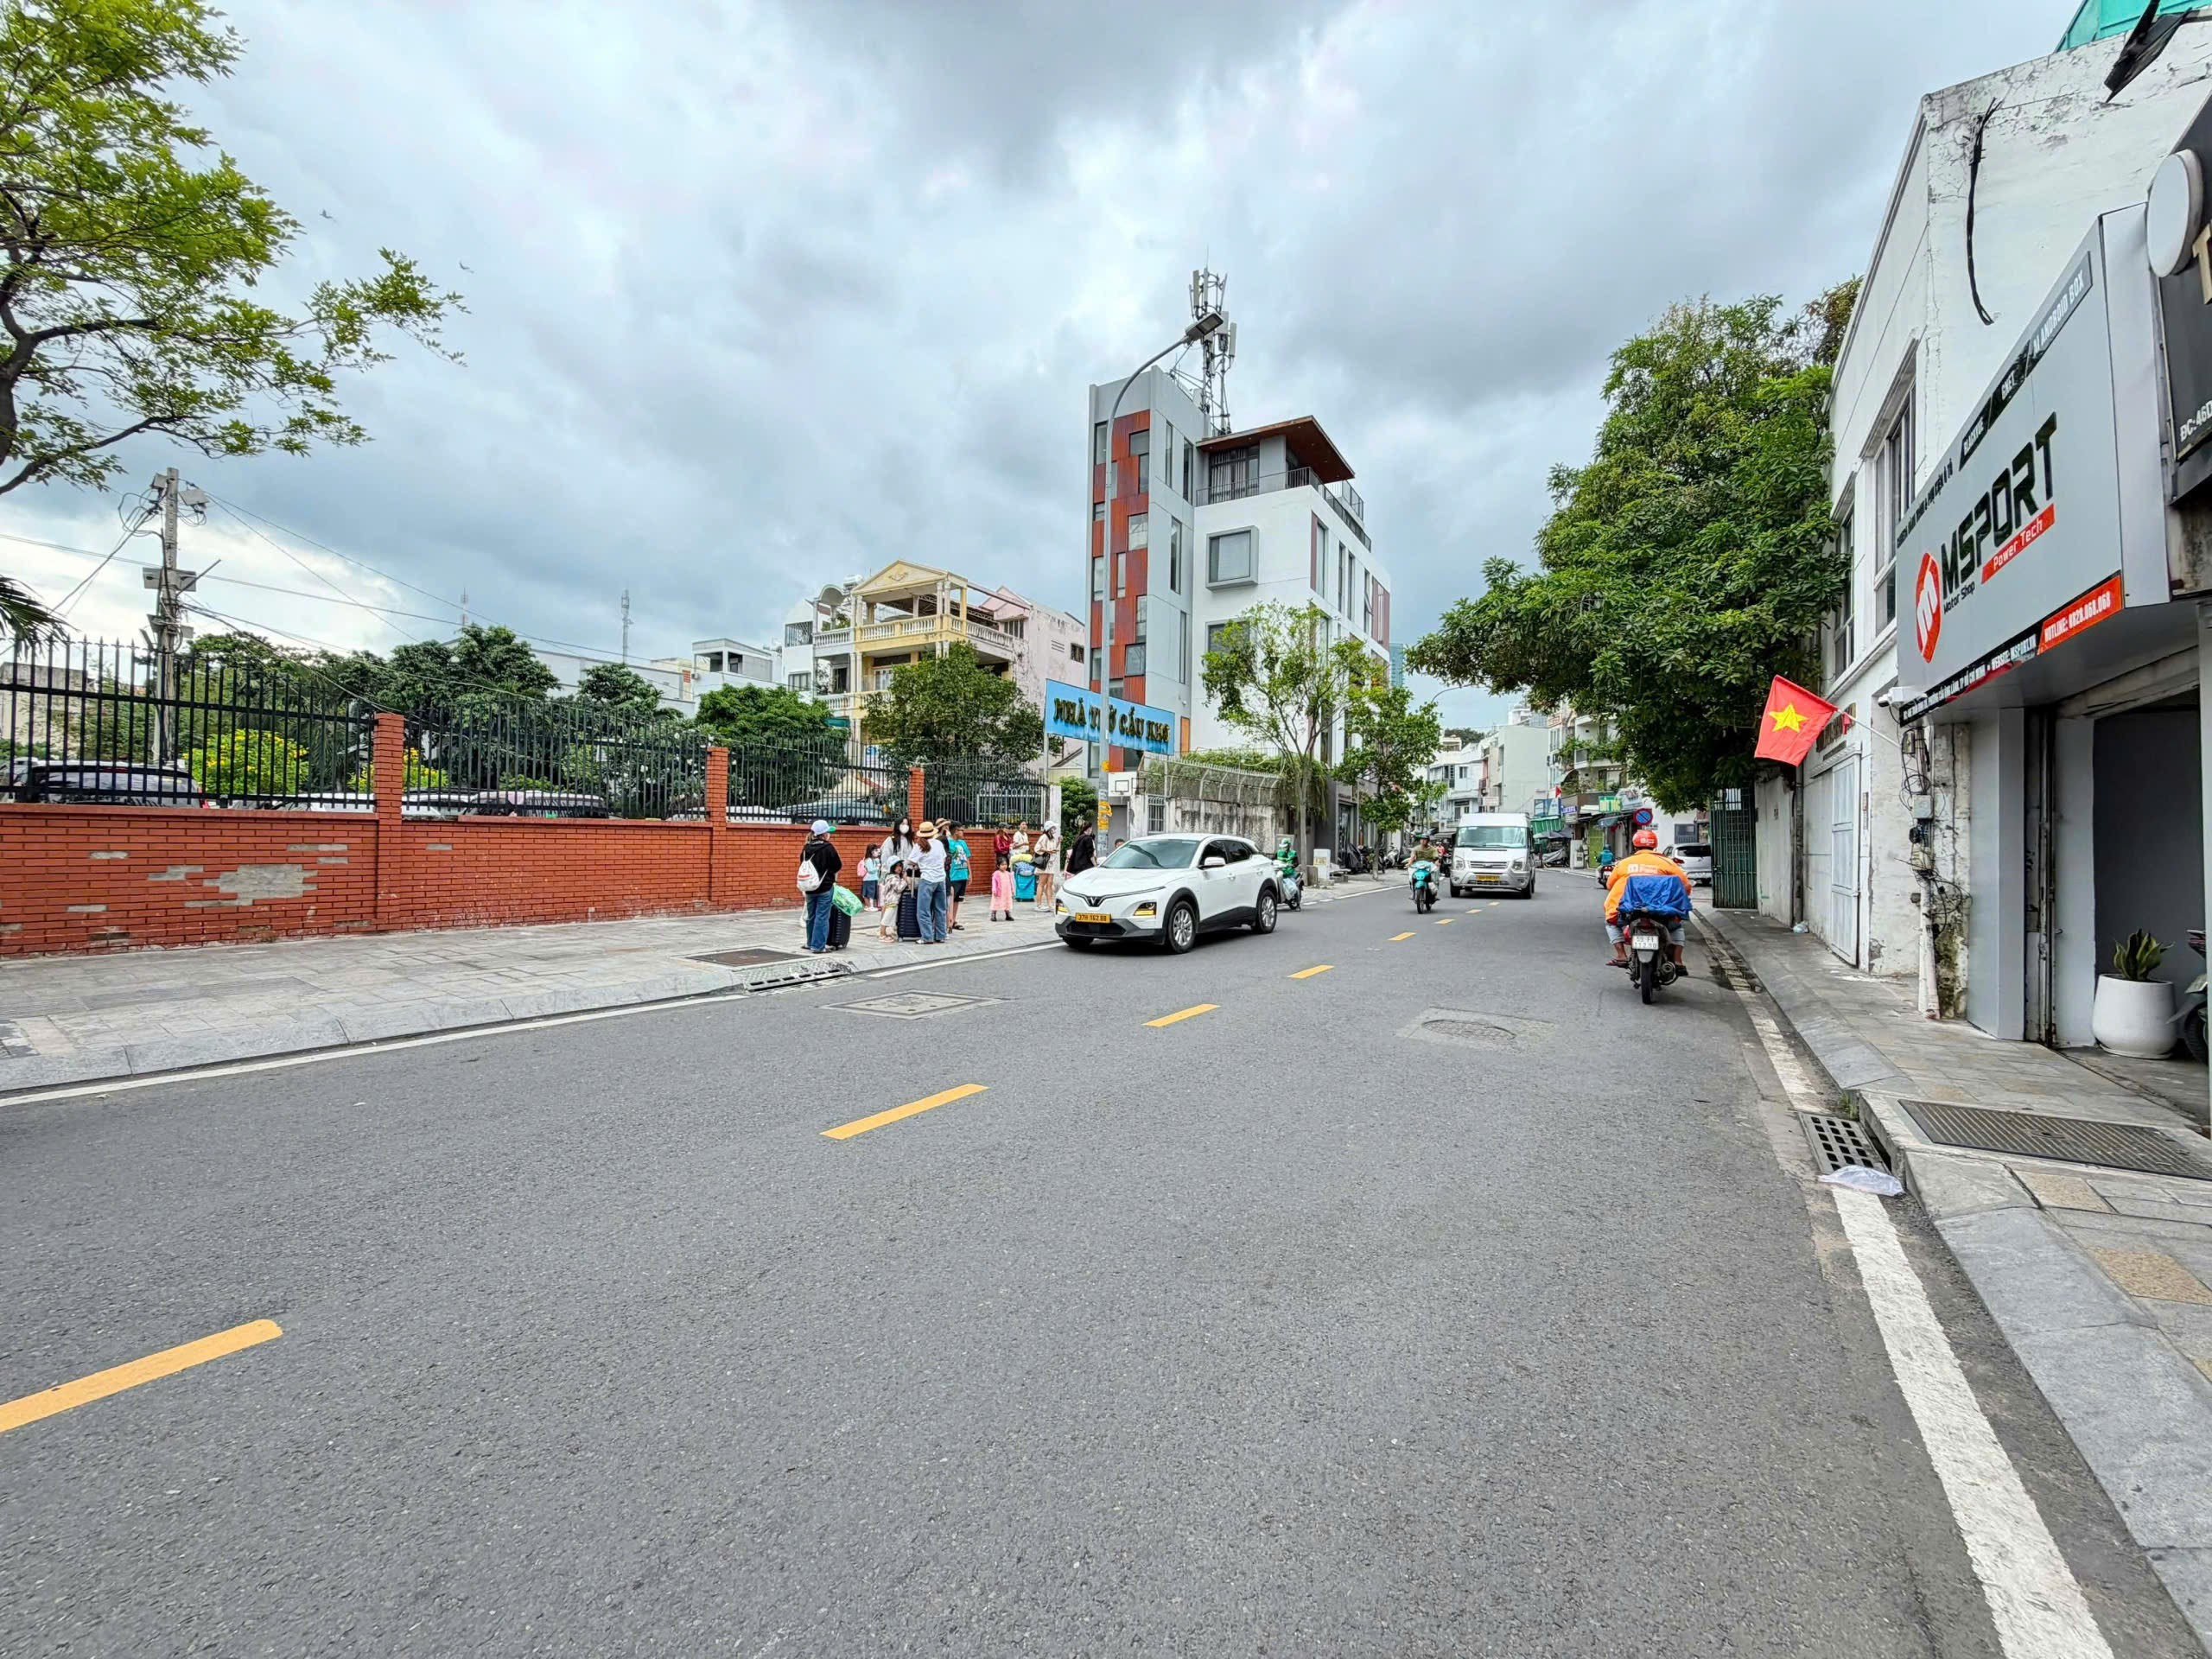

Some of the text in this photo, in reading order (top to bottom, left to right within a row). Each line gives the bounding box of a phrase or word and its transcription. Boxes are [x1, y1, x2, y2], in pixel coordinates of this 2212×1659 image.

[2040, 292, 2069, 346] ANDROID
[2069, 270, 2084, 304] BOX
[1941, 410, 2057, 600] MSPORT
[1993, 518, 2043, 571] Power Tech
[1943, 581, 1975, 614] Motor Shop
[2044, 617, 2069, 644] HOTLINE:
[1053, 696, 1087, 726] NHÀ
